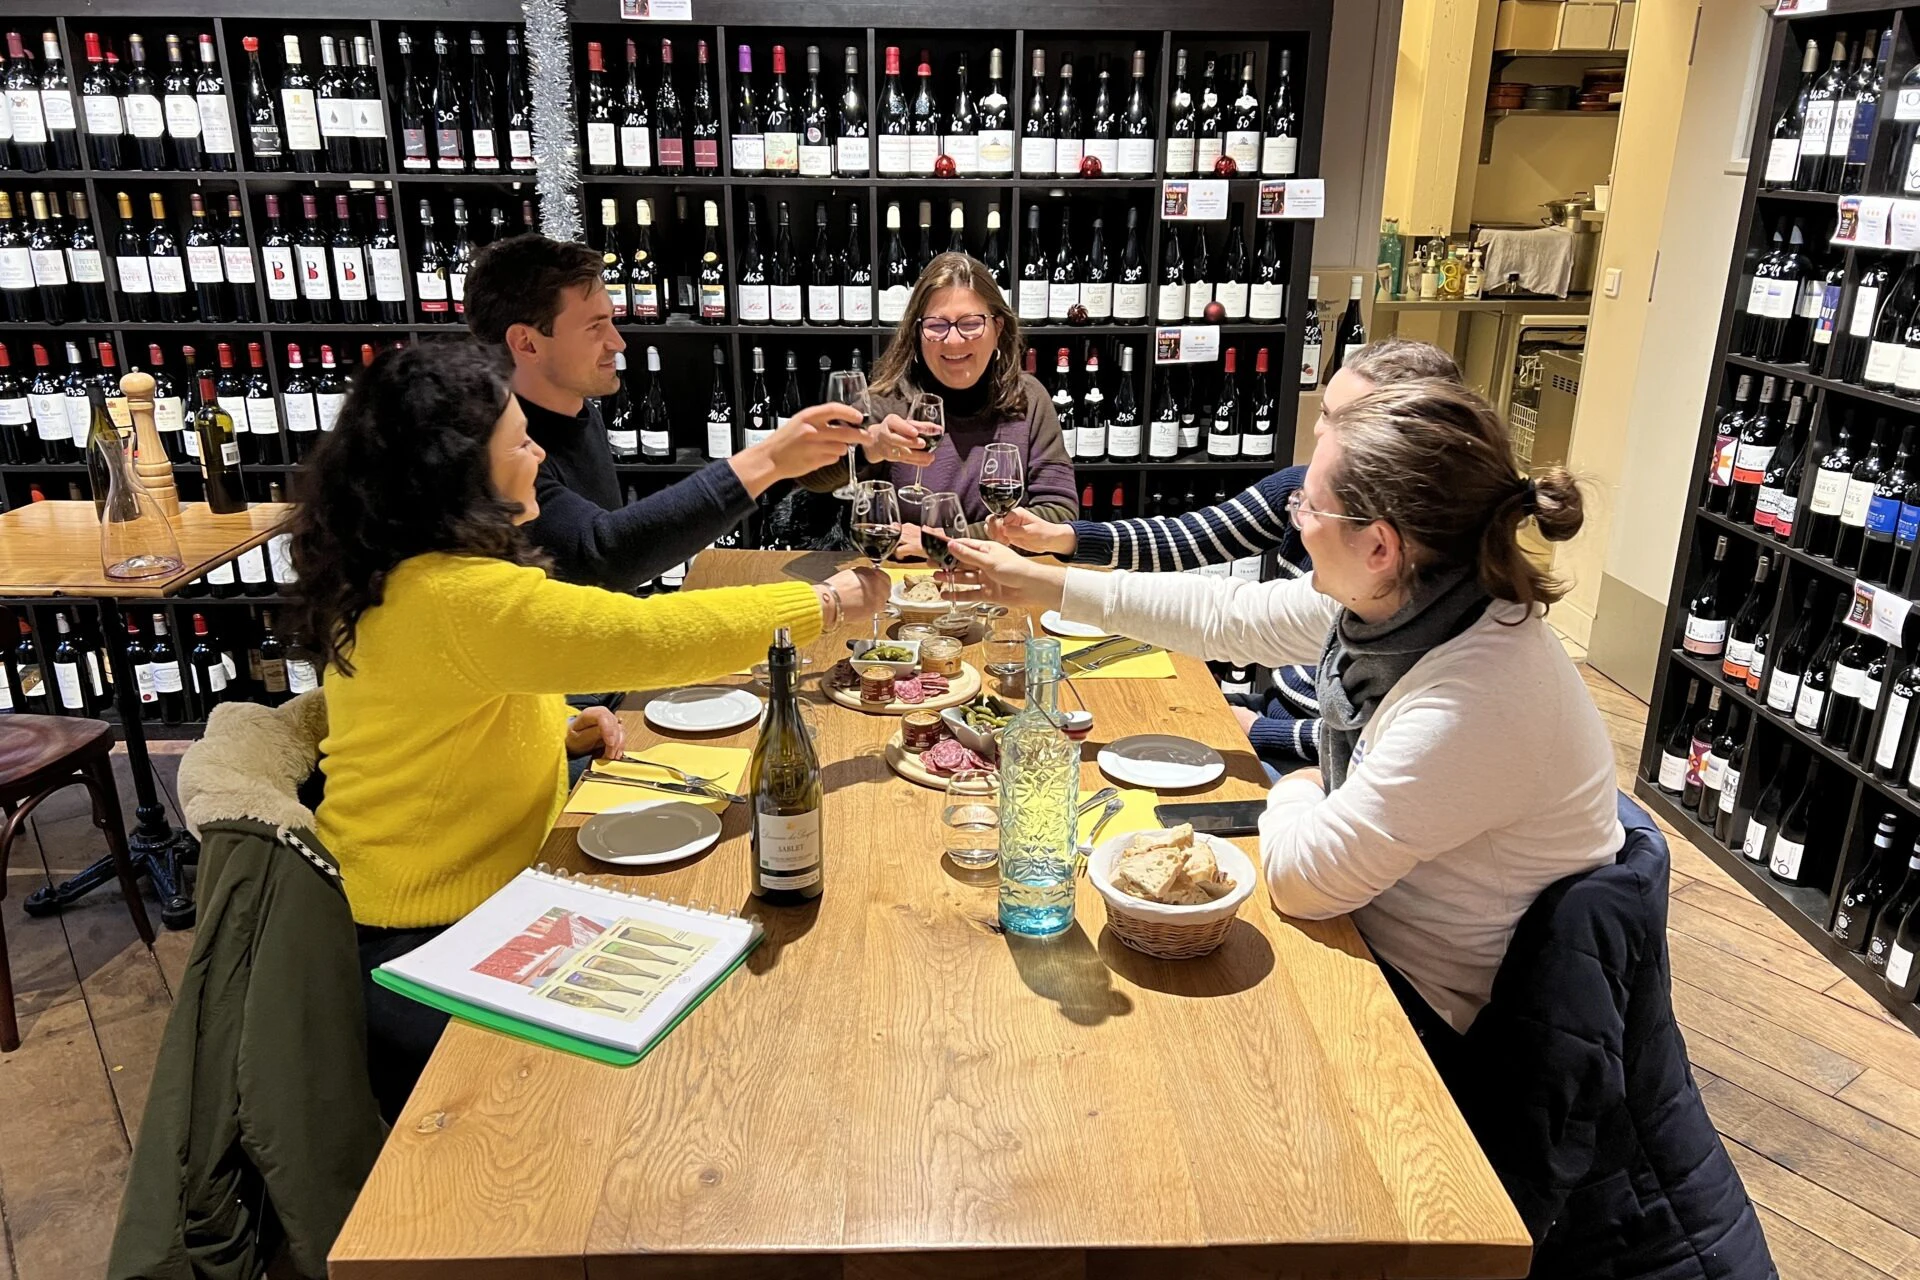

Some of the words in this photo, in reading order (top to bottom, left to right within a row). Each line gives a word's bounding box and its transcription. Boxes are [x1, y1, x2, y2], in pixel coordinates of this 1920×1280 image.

[272, 261, 285, 280] B
[306, 261, 319, 279] B
[343, 262, 356, 281] B
[778, 844, 803, 852] SABLET
